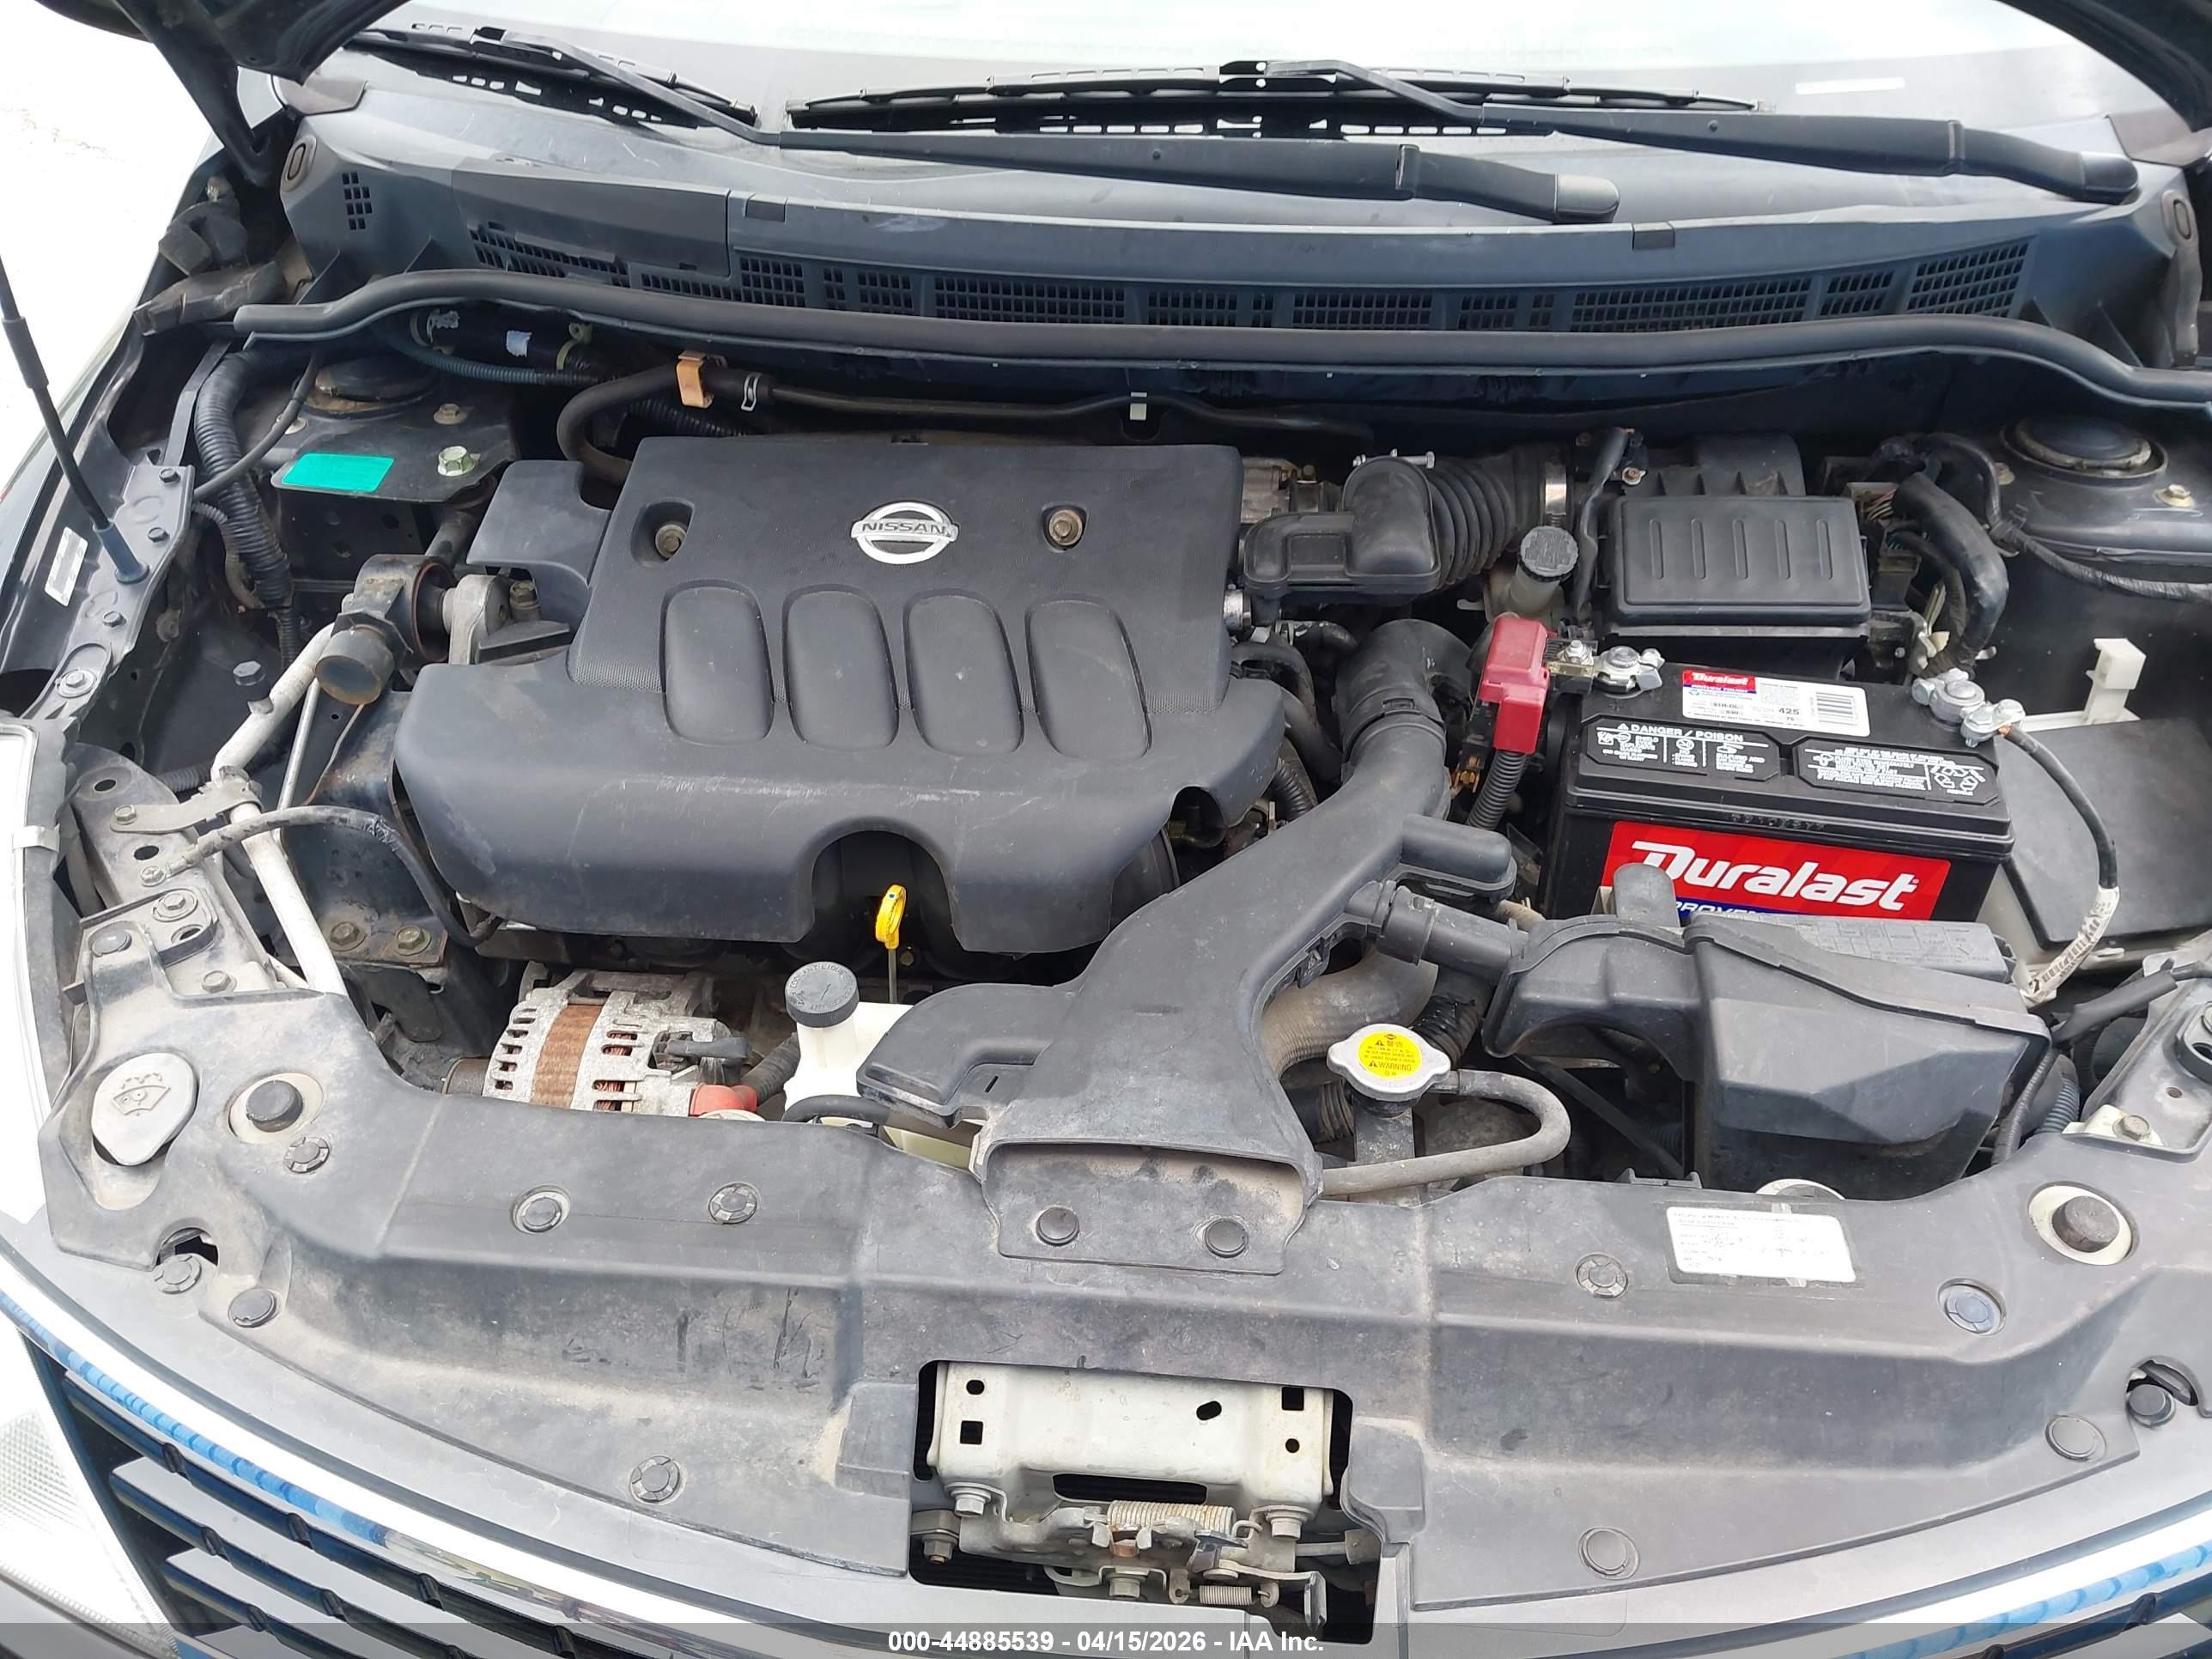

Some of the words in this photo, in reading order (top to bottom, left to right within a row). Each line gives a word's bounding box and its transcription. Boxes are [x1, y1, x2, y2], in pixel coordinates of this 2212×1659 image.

[861, 521, 946, 534] NISSAN
[1692, 672, 1749, 686] Duralast
[1631, 724, 1683, 737] DANGER
[1695, 730, 1744, 743] POISON
[1631, 840, 1919, 912] Duralast
[1377, 1060, 1413, 1072] WARNING
